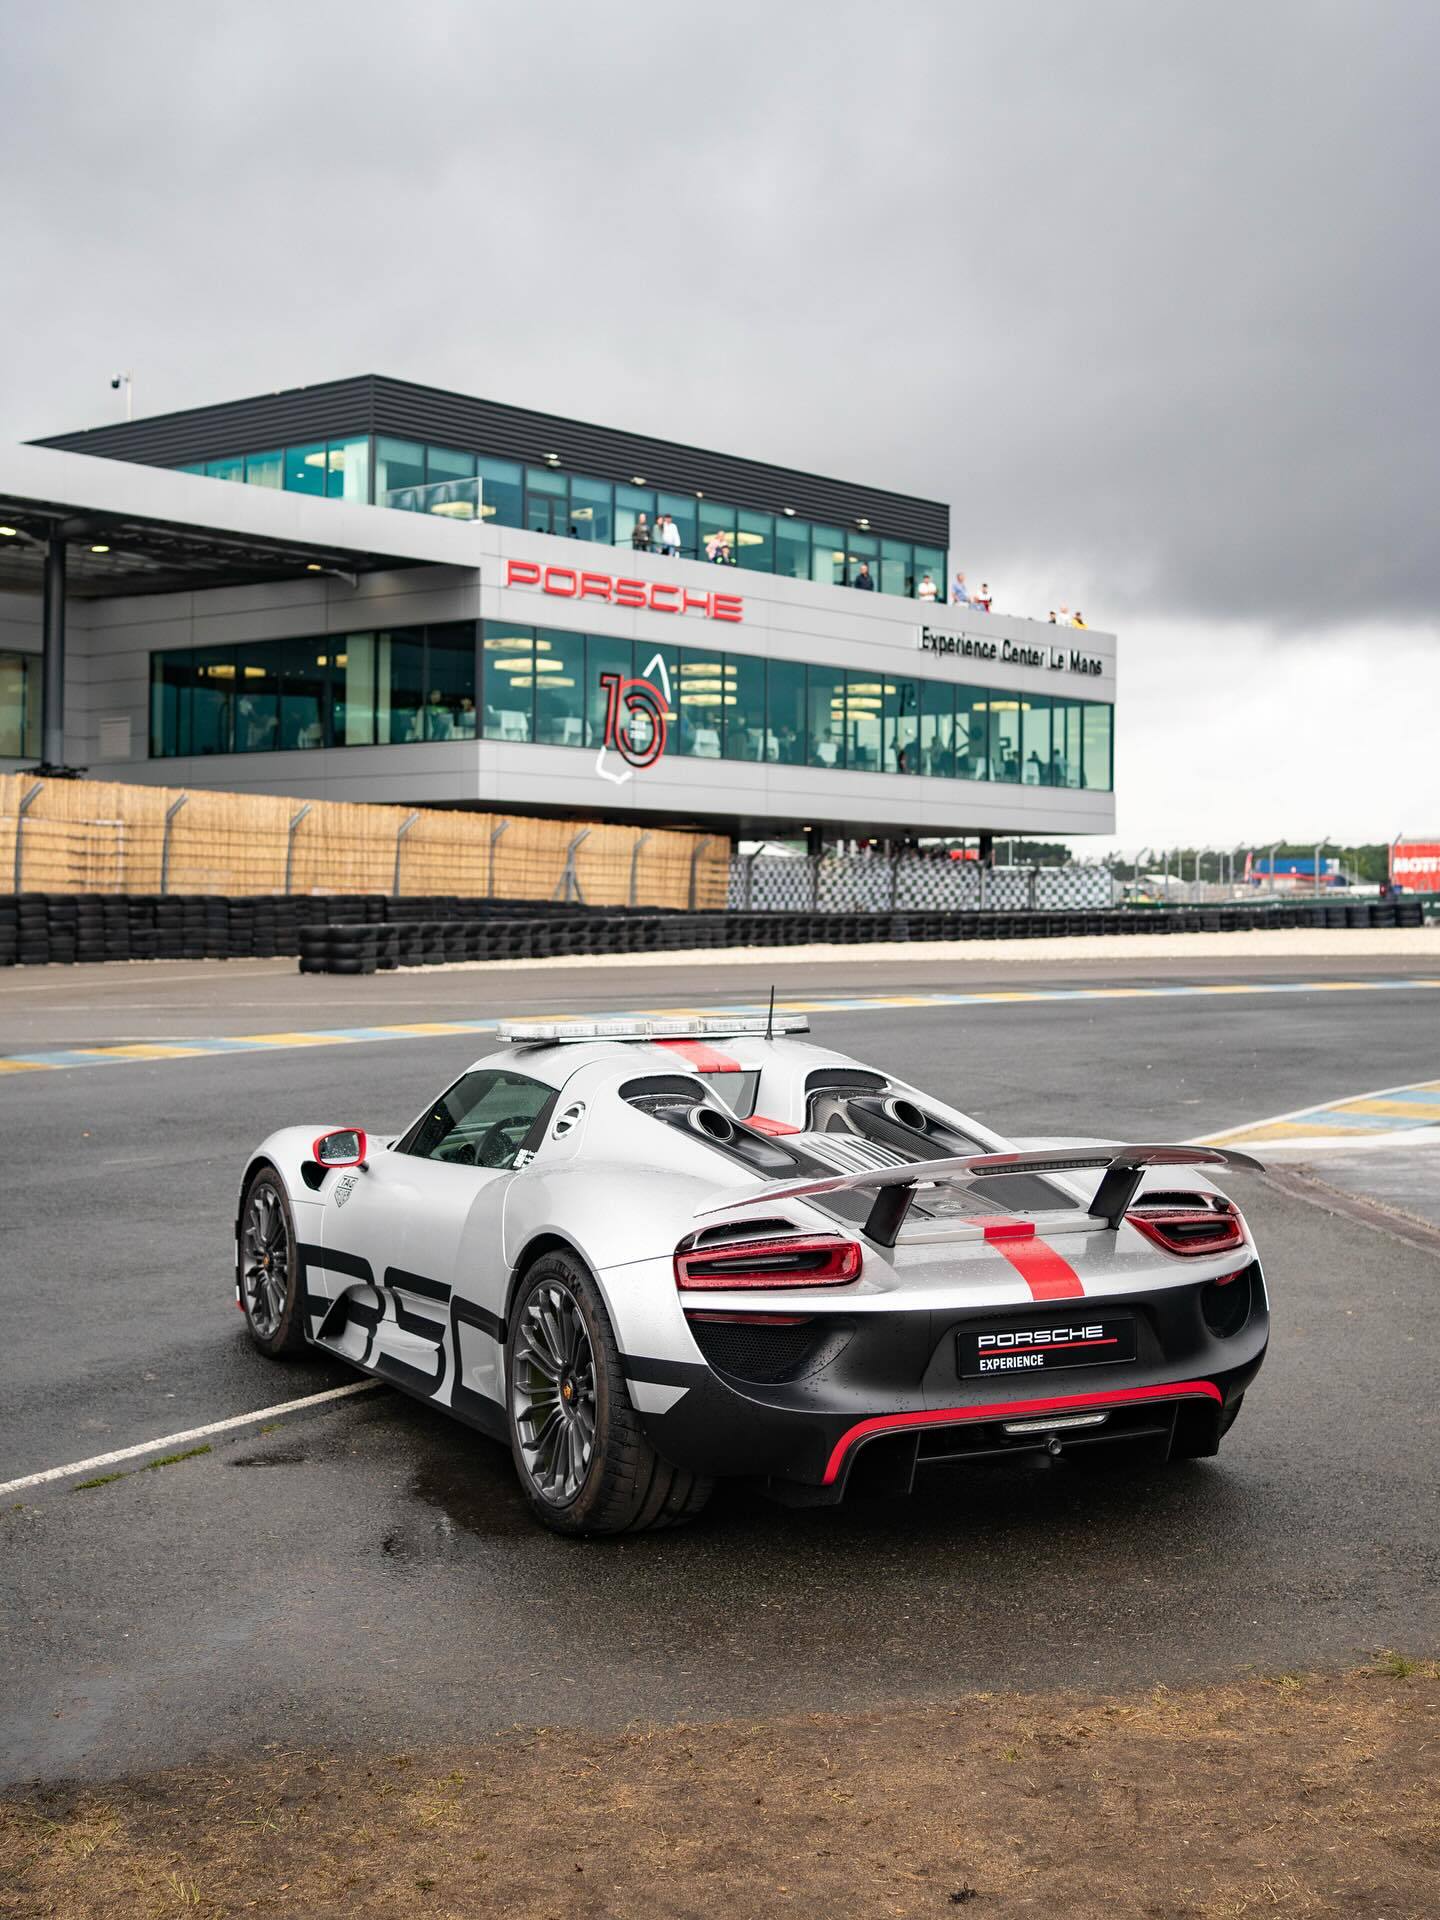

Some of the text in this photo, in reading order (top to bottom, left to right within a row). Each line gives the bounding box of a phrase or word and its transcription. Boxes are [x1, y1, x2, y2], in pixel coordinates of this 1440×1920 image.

[507, 559, 743, 623] PORSCHE
[921, 625, 1103, 677] Experience Center Le Mans
[977, 1325, 1103, 1349] PORSCHE
[979, 1354, 1044, 1371] EXPERIENCE
